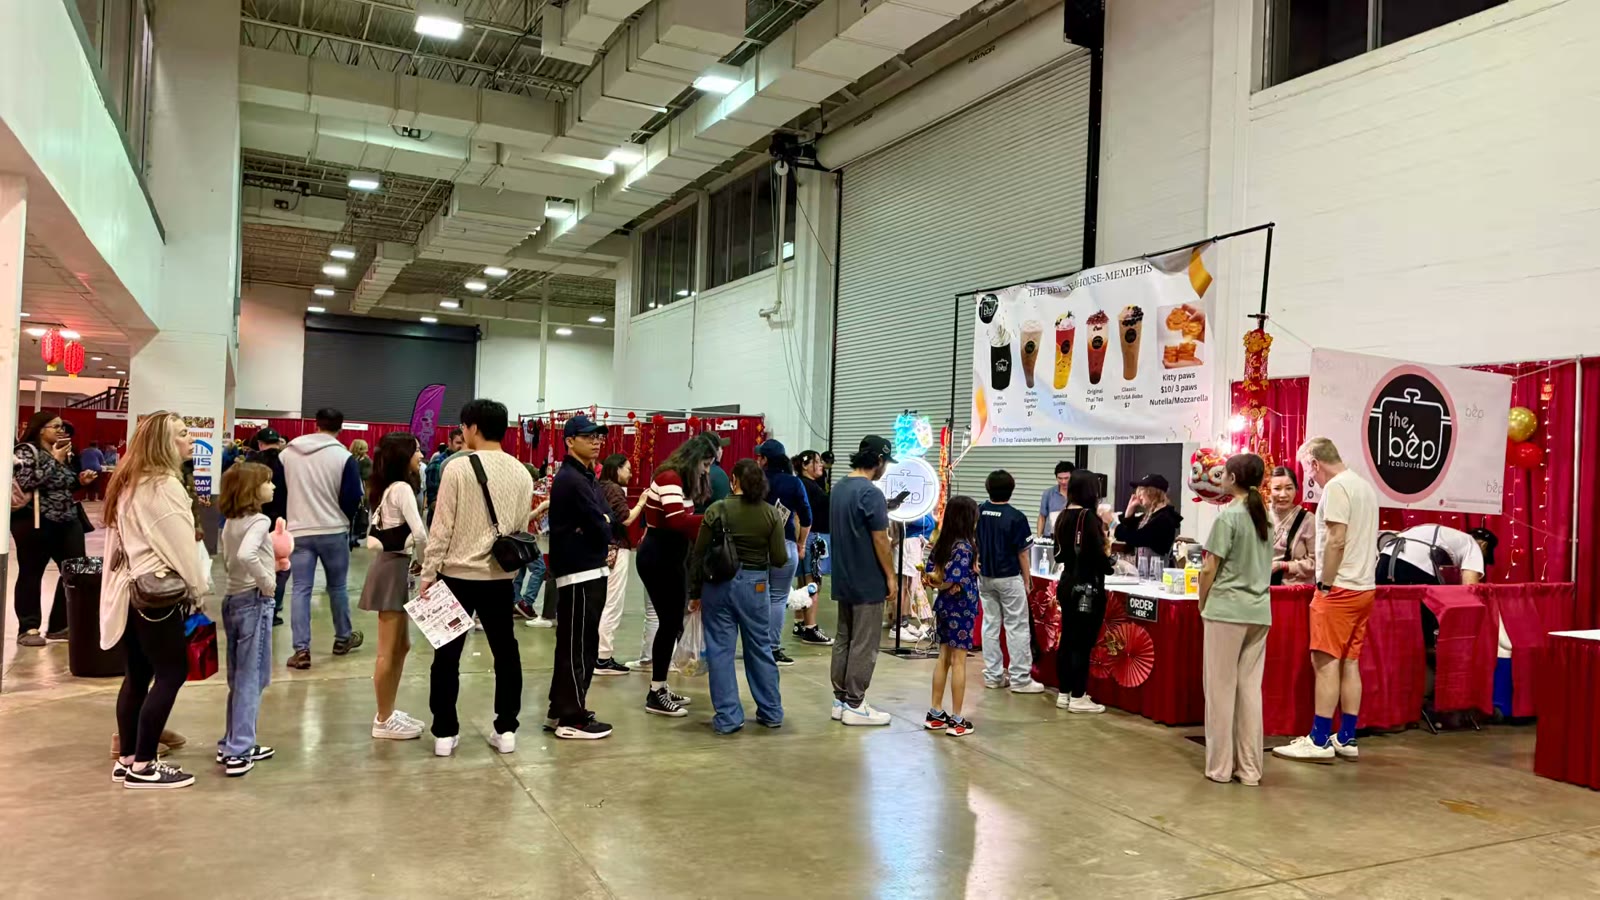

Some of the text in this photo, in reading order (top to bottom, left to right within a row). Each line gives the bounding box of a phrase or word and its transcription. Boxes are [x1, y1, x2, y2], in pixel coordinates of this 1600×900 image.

[1028, 287, 1046, 298] THE
[1162, 372, 1196, 382] Kitty paws
[1160, 384, 1198, 394] $10/ 3 paws
[1149, 394, 1209, 406] Nutella/Mozzarella
[1388, 410, 1409, 429] the
[1388, 460, 1421, 469] teahouse
[1129, 597, 1154, 611] ORDER
[1135, 609, 1147, 618] HERE
